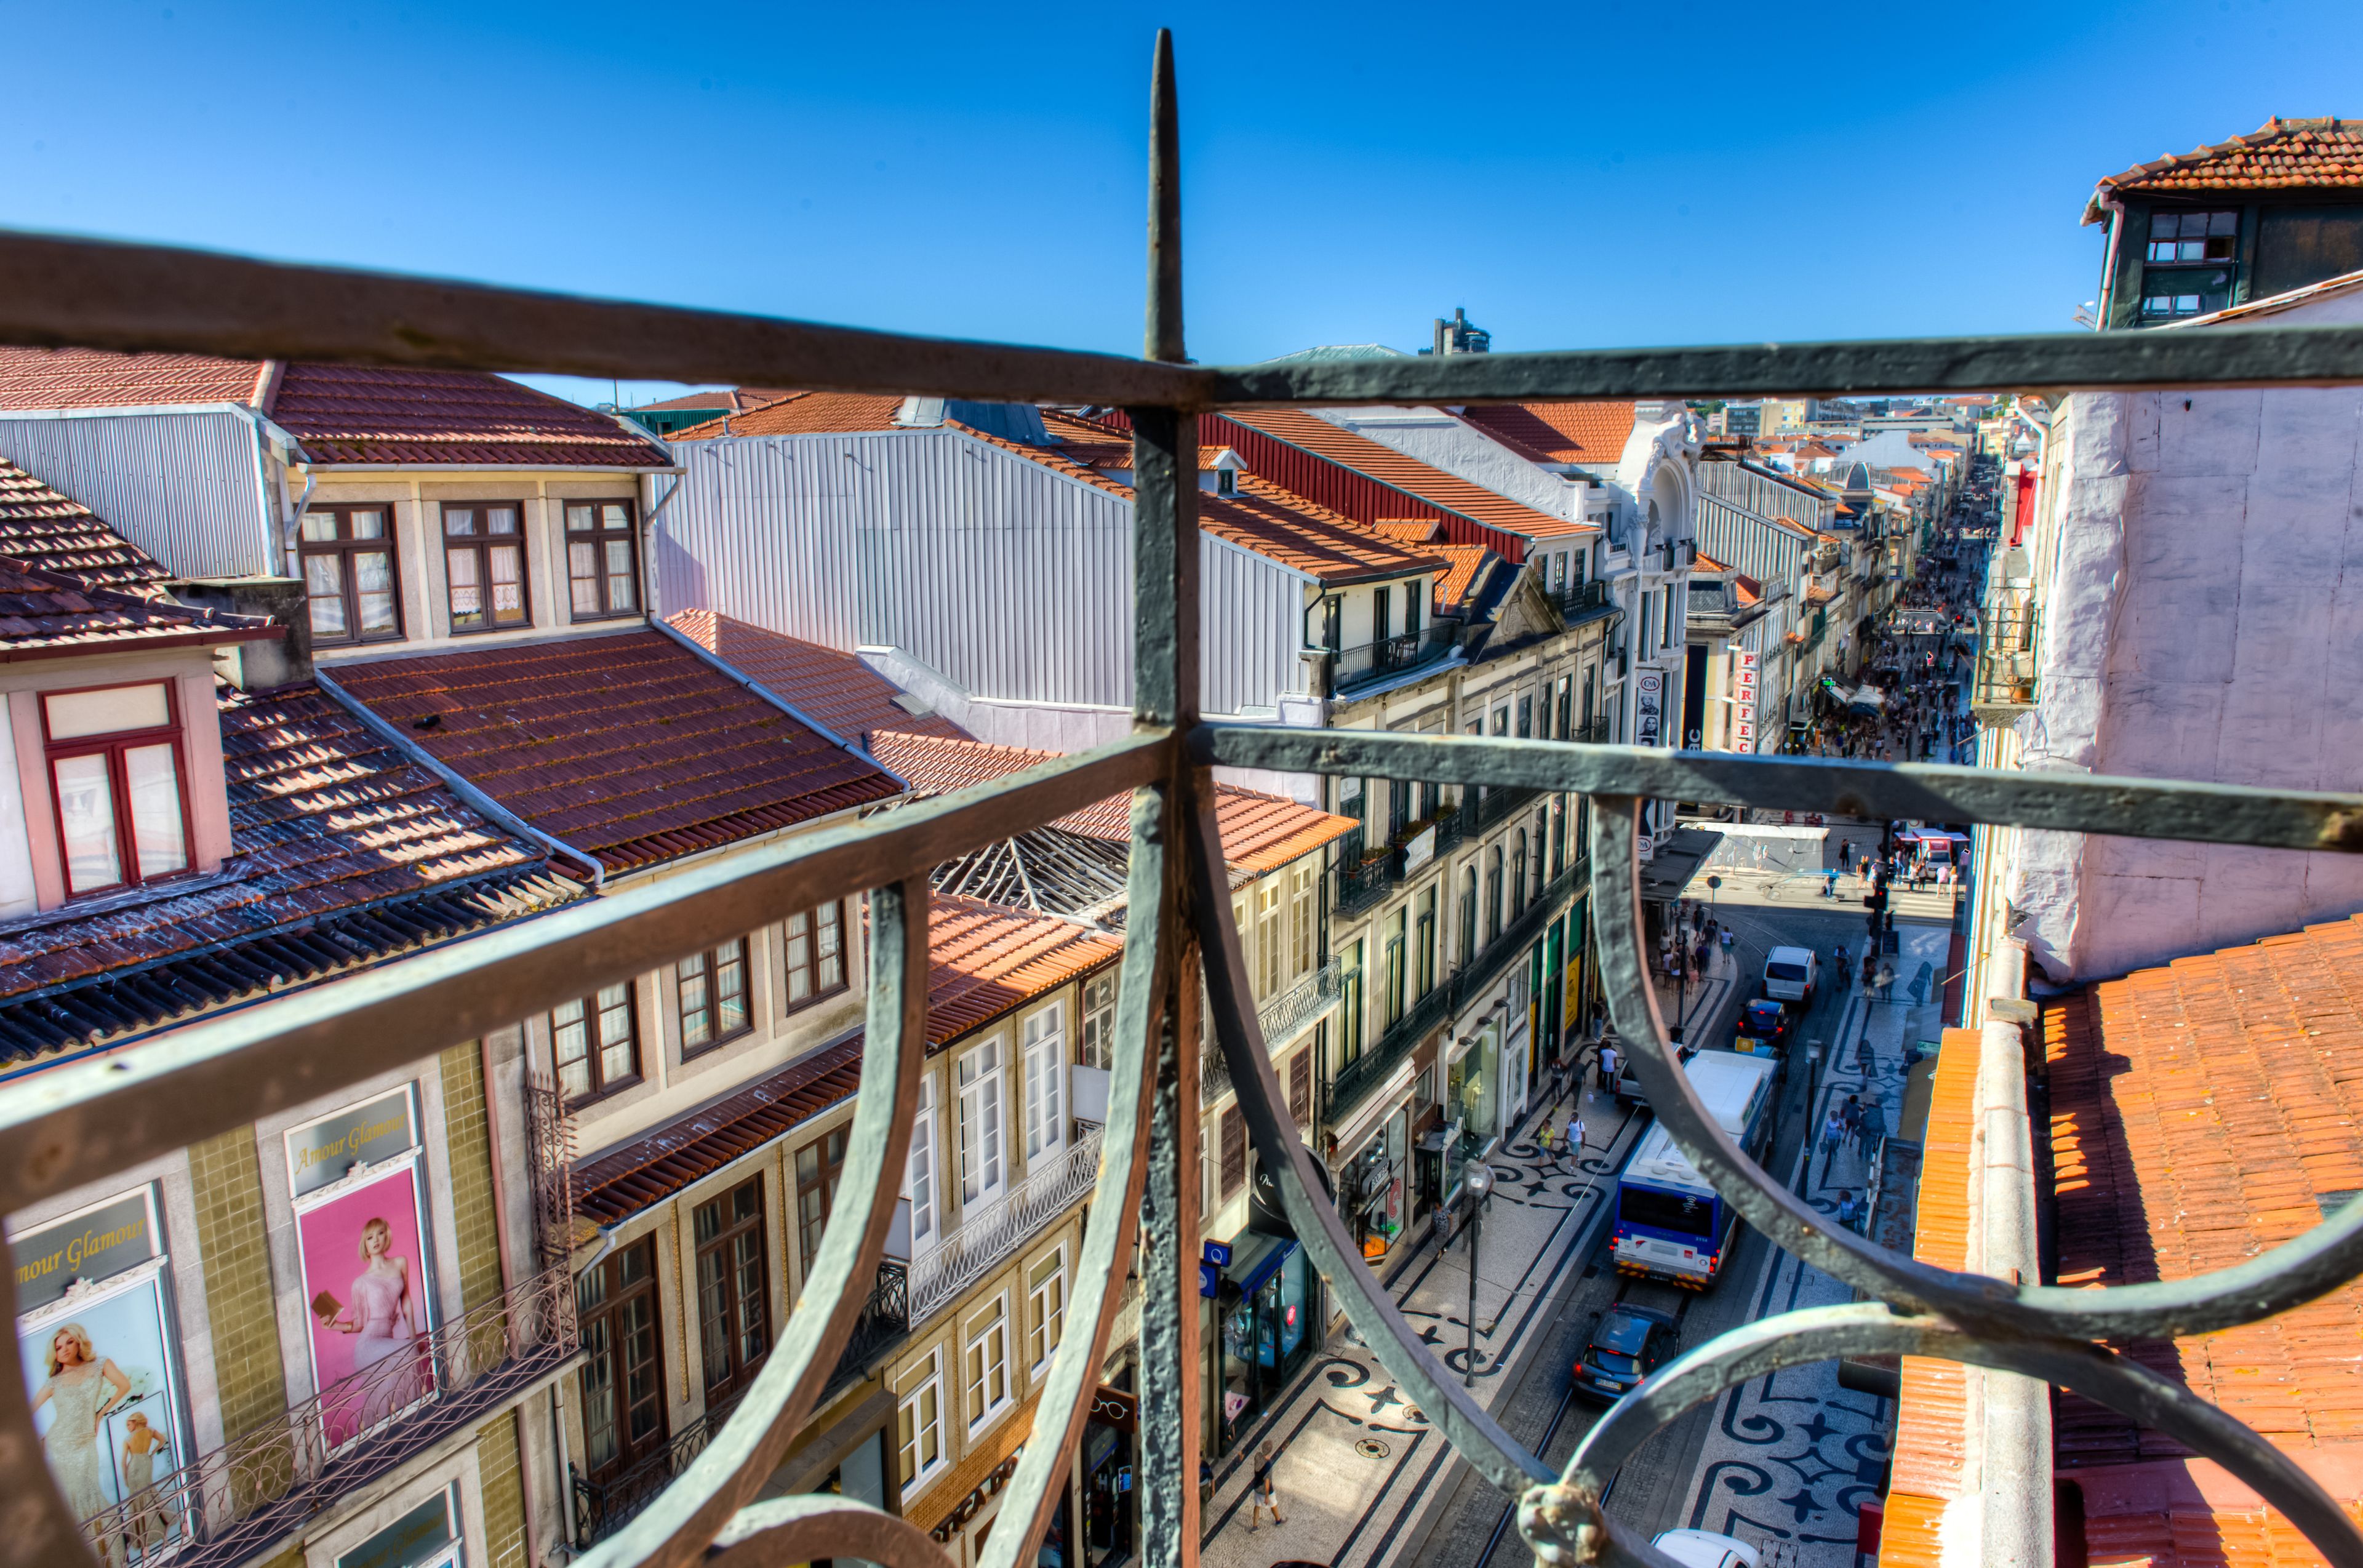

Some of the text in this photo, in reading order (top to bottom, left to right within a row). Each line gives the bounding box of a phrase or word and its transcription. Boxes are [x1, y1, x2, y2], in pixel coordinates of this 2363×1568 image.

[295, 1113, 406, 1175] Amour Glamour
[15, 1218, 146, 1285] mour Glamour
